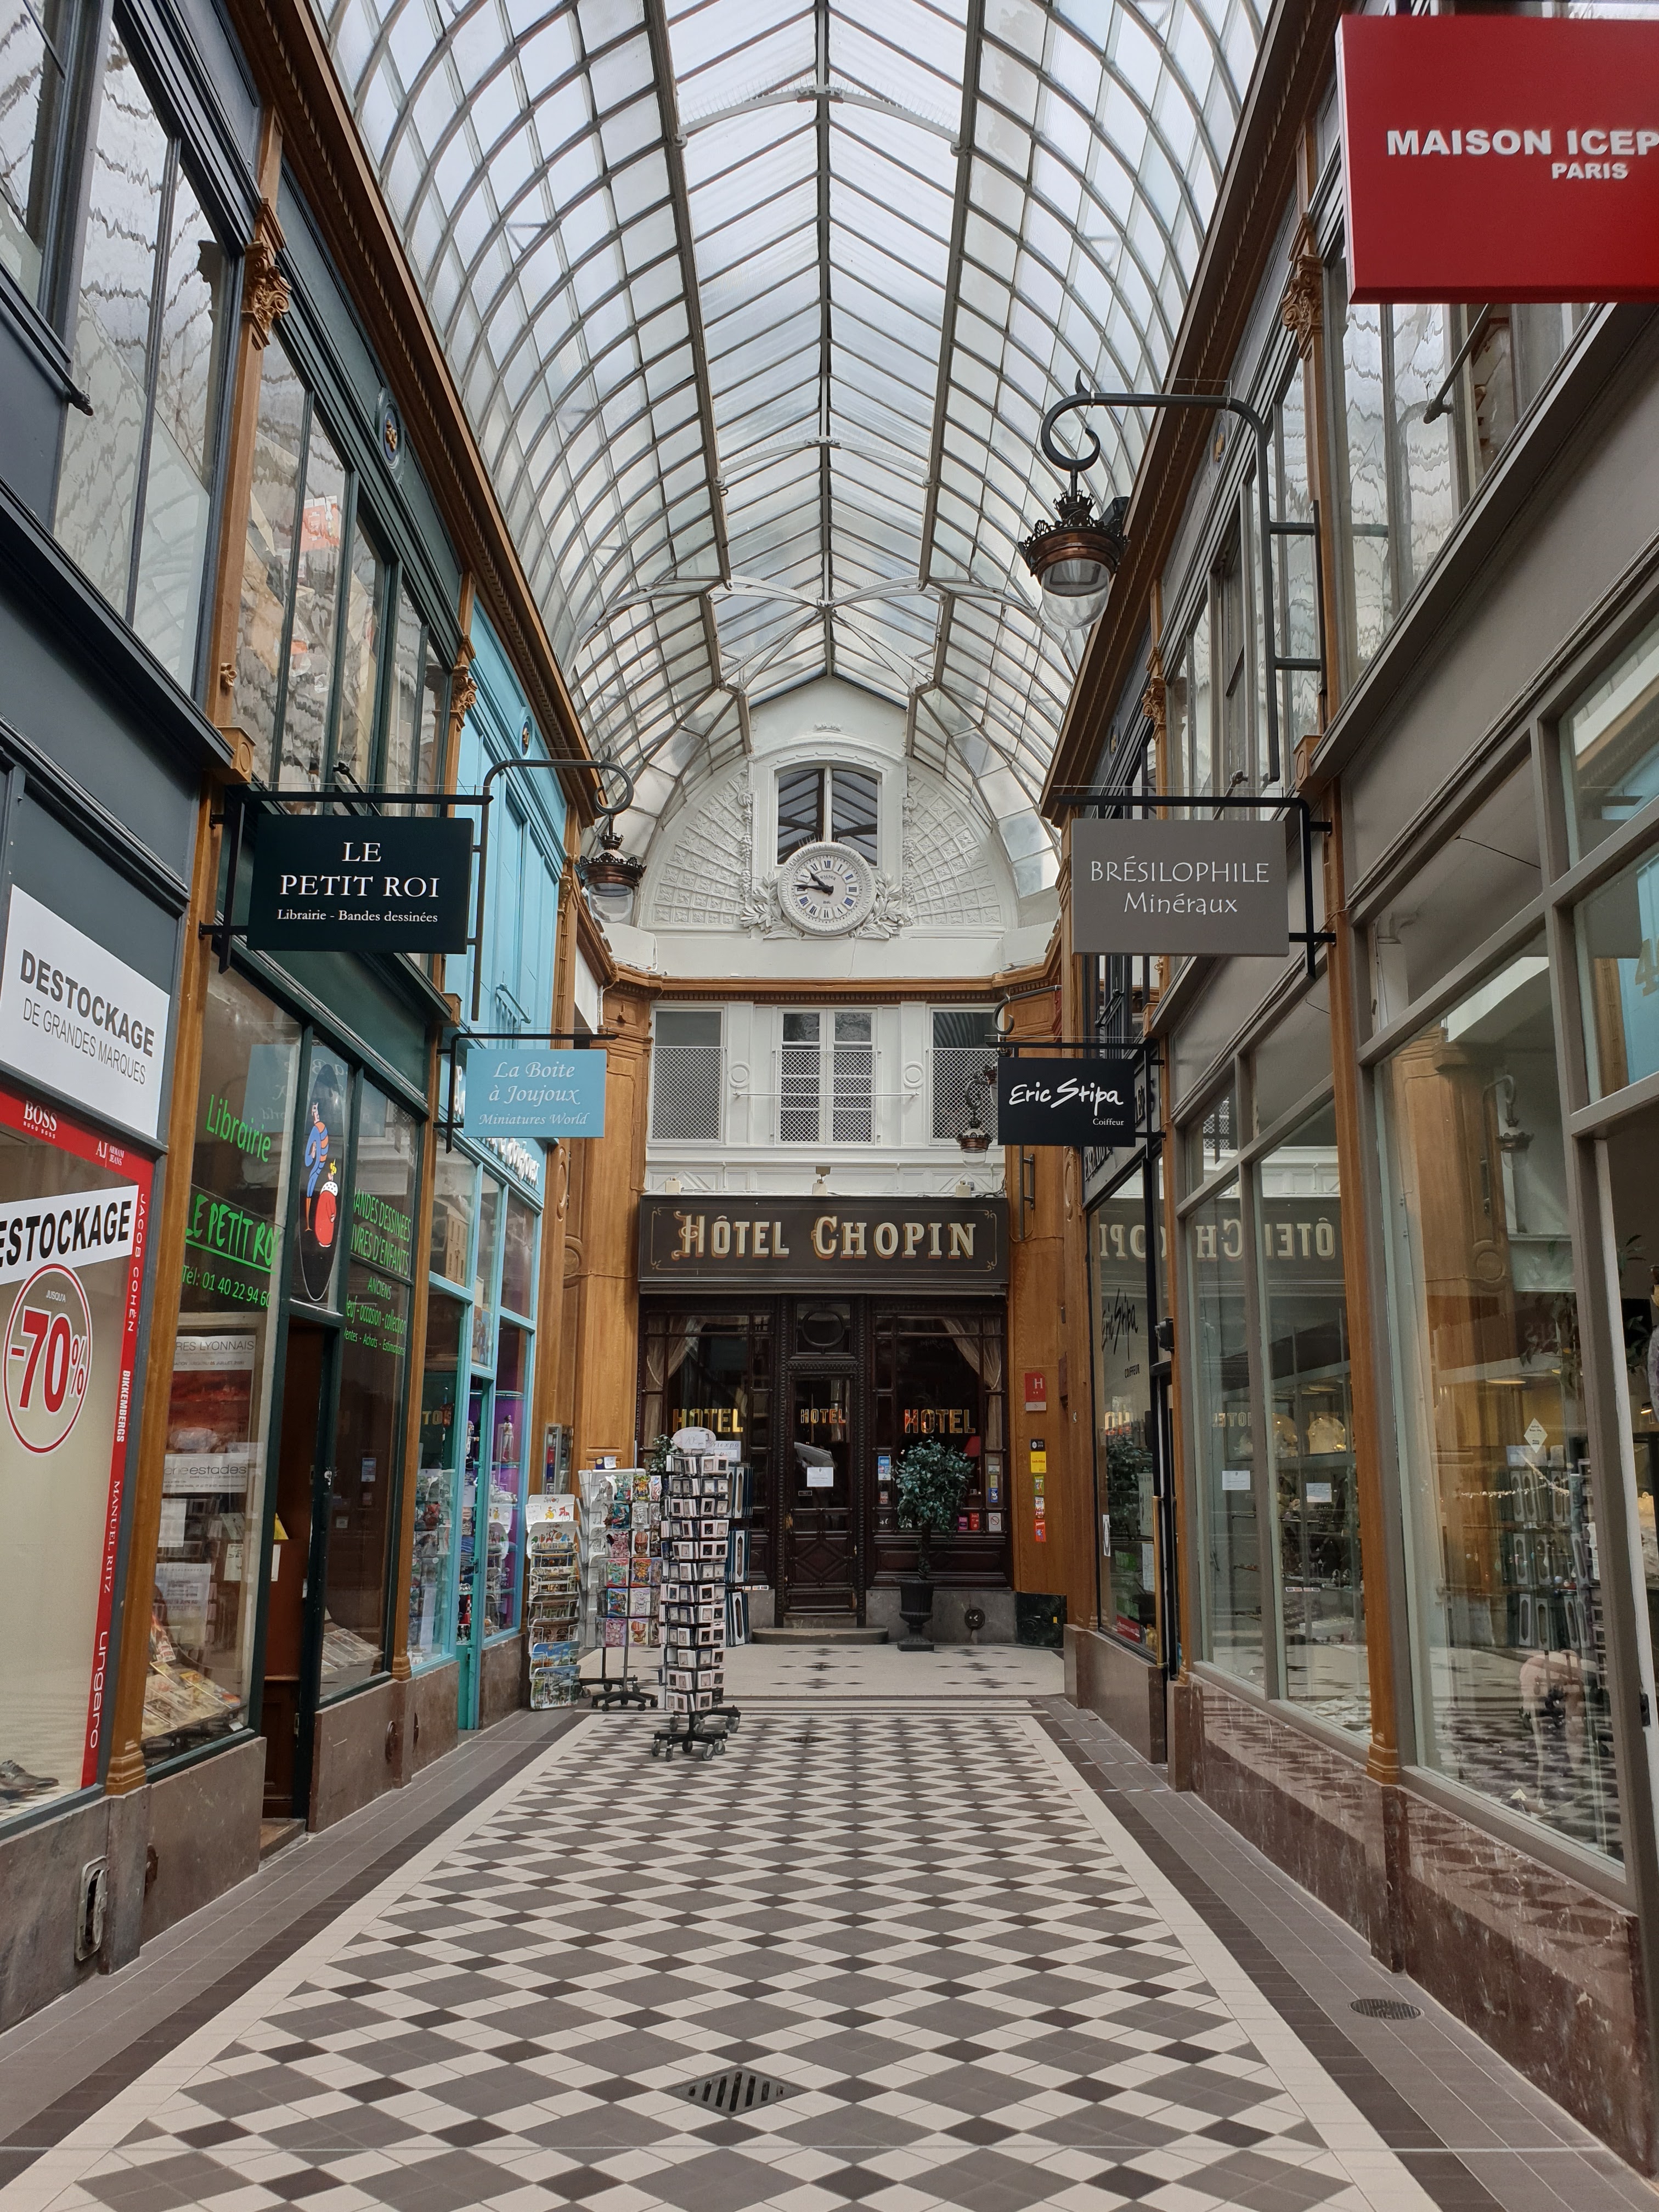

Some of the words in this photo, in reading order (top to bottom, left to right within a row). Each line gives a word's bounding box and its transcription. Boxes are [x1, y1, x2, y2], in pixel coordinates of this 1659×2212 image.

[1386, 129, 1553, 156] MAISON
[1551, 162, 1629, 180] PARIS
[342, 842, 382, 862] LE
[1091, 855, 1269, 883] BRÉSILOPHILE
[280, 875, 373, 897] PETIT
[383, 877, 440, 898] ROI
[276, 909, 327, 921] Librairie
[338, 910, 381, 922] Bandes
[384, 911, 438, 923] dessinées
[1124, 891, 1238, 916] Minéraux
[20, 949, 155, 1057] DESTOCKAGE
[23, 997, 41, 1028] DE
[43, 1010, 95, 1057] GRANDES
[99, 1041, 146, 1085] MARQUES
[493, 1062, 520, 1078] La
[526, 1061, 575, 1078] Boite
[489, 1085, 500, 1102] à
[504, 1085, 581, 1107] Joujoux
[1009, 1081, 1052, 1105] Eric
[1050, 1077, 1124, 1116] Stipa
[23, 1121, 38, 1131] HUGO
[41, 1128, 55, 1139] BOSS
[24, 1100, 57, 1131] BOSS
[206, 1094, 271, 1163] Librairie
[478, 1113, 546, 1125] Miniatures
[550, 1112, 590, 1125] World
[95, 1141, 108, 1159] AJ
[134, 1194, 146, 1258] JACOB
[185, 1194, 209, 1238] E
[208, 1203, 253, 1260] PETIT
[253, 1222, 280, 1266] ROI
[353, 1188, 379, 1224] ANDES
[379, 1201, 411, 1243] DESSINEES
[671, 1210, 789, 1261] HÔTEL
[811, 1215, 977, 1260] CHOPIN
[373, 1235, 409, 1276] D'ENFANTS
[128, 1267, 140, 1332] COHËN
[182, 1265, 200, 1286] Tél:
[201, 1272, 215, 1291] 01
[217, 1277, 231, 1295] 40
[232, 1281, 245, 1300] 22
[246, 1286, 259, 1304] 94
[260, 1291, 272, 1308] 60
[368, 1276, 392, 1300] ANCIENS
[359, 1305, 382, 1327] occasion
[385, 1309, 408, 1335] collection
[200, 1340, 255, 1351] LYONNAIS
[363, 1333, 378, 1348] Achats
[382, 1339, 407, 1356] Estimations
[10, 1306, 87, 1416] -70%
[116, 1370, 131, 1443] BIKKEMBERGS
[673, 1408, 743, 1432] HOTEL
[800, 1408, 846, 1424] HOTEL
[905, 1409, 976, 1434] HOTEL
[108, 1481, 120, 1551] MANUEL
[104, 1555, 113, 1594] RITZ
[90, 1630, 108, 1749] ungaro
